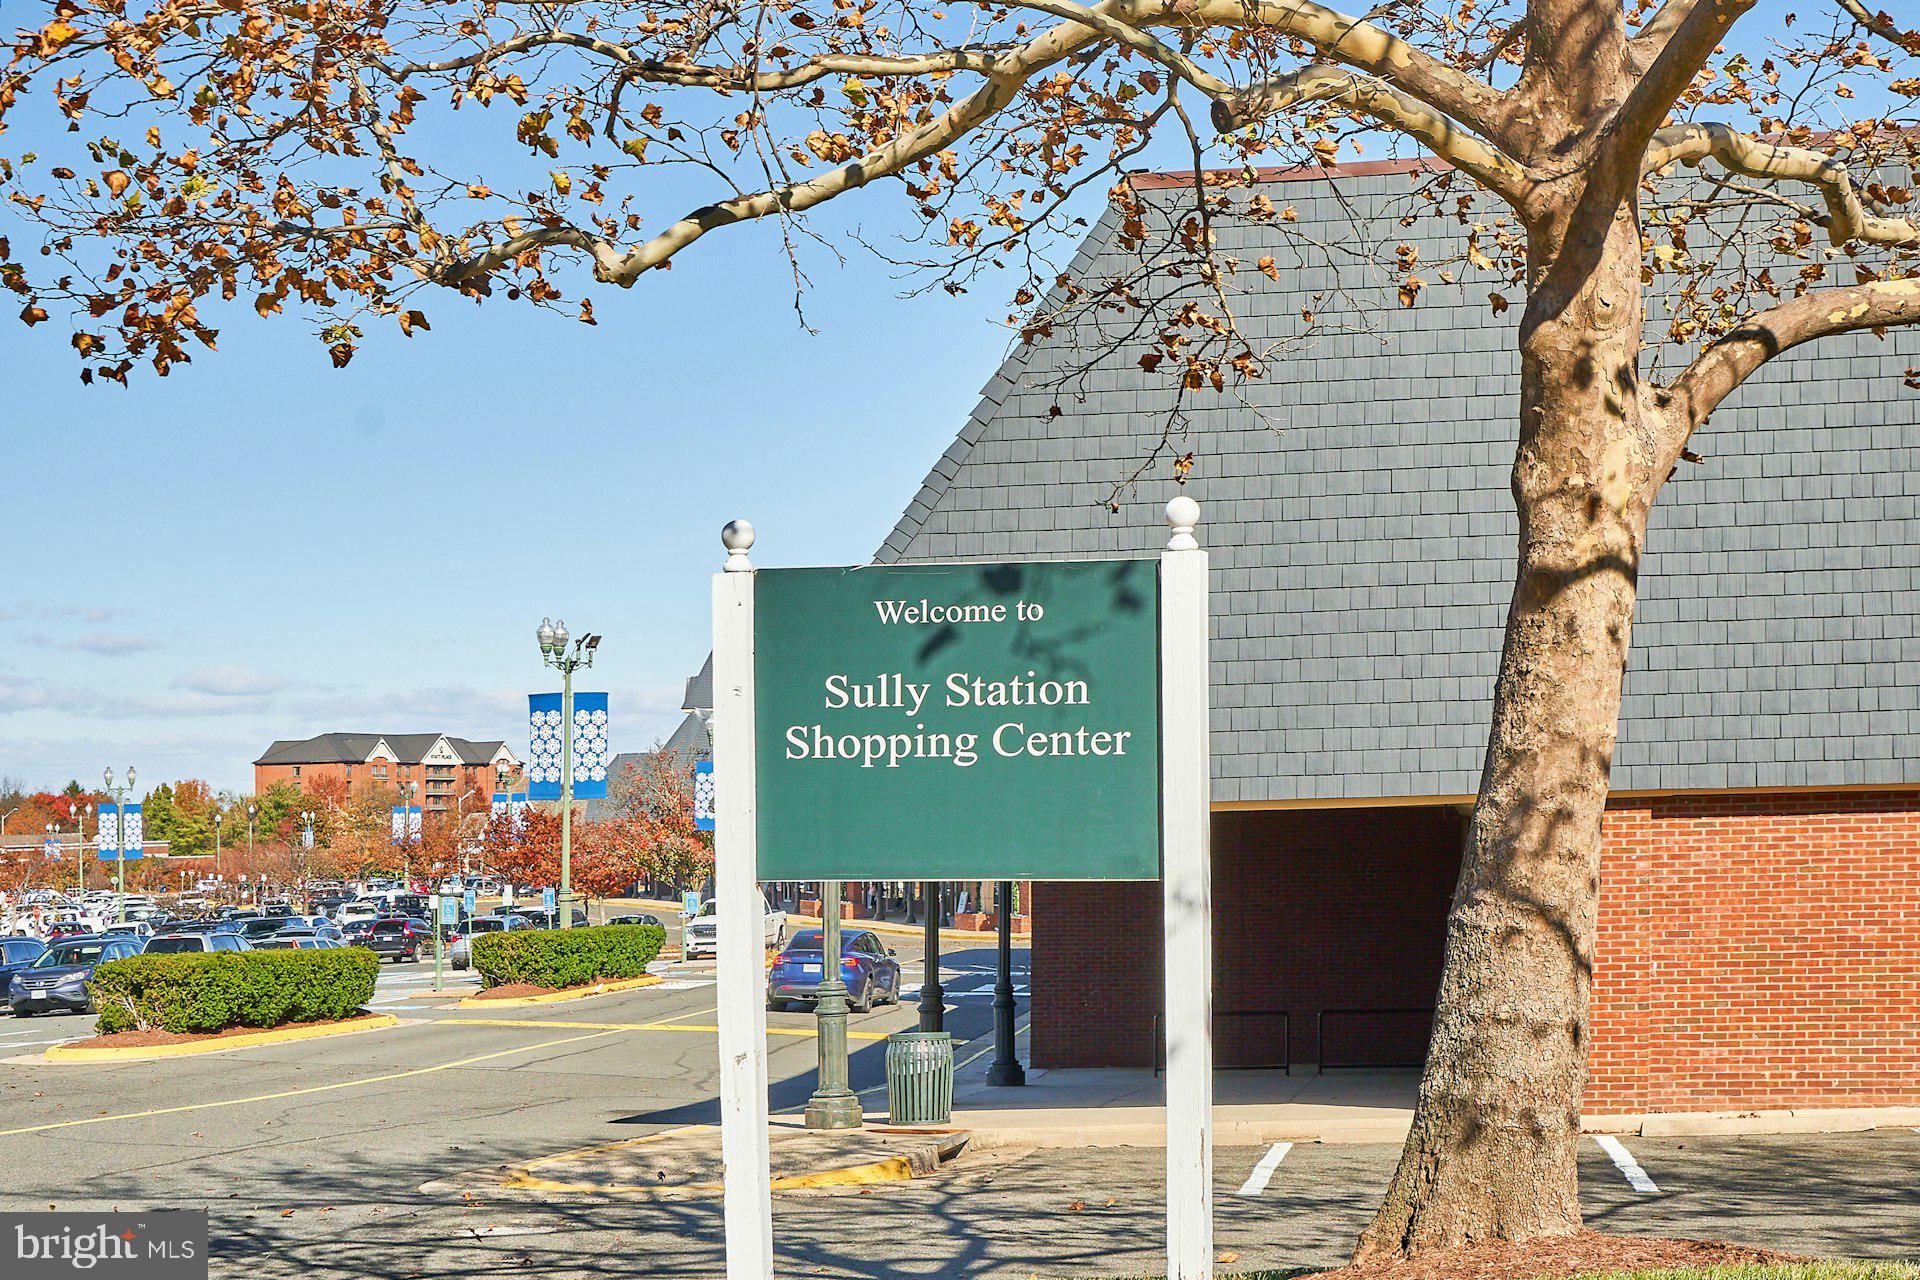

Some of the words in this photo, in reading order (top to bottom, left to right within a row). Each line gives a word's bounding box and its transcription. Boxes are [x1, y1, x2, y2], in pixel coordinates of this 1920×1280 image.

[873, 598, 1007, 625] Welcome
[1015, 599, 1045, 622] to
[825, 673, 932, 717] Sully
[945, 670, 1091, 708] Station
[785, 723, 979, 769] Shopping
[991, 722, 1132, 757] Center
